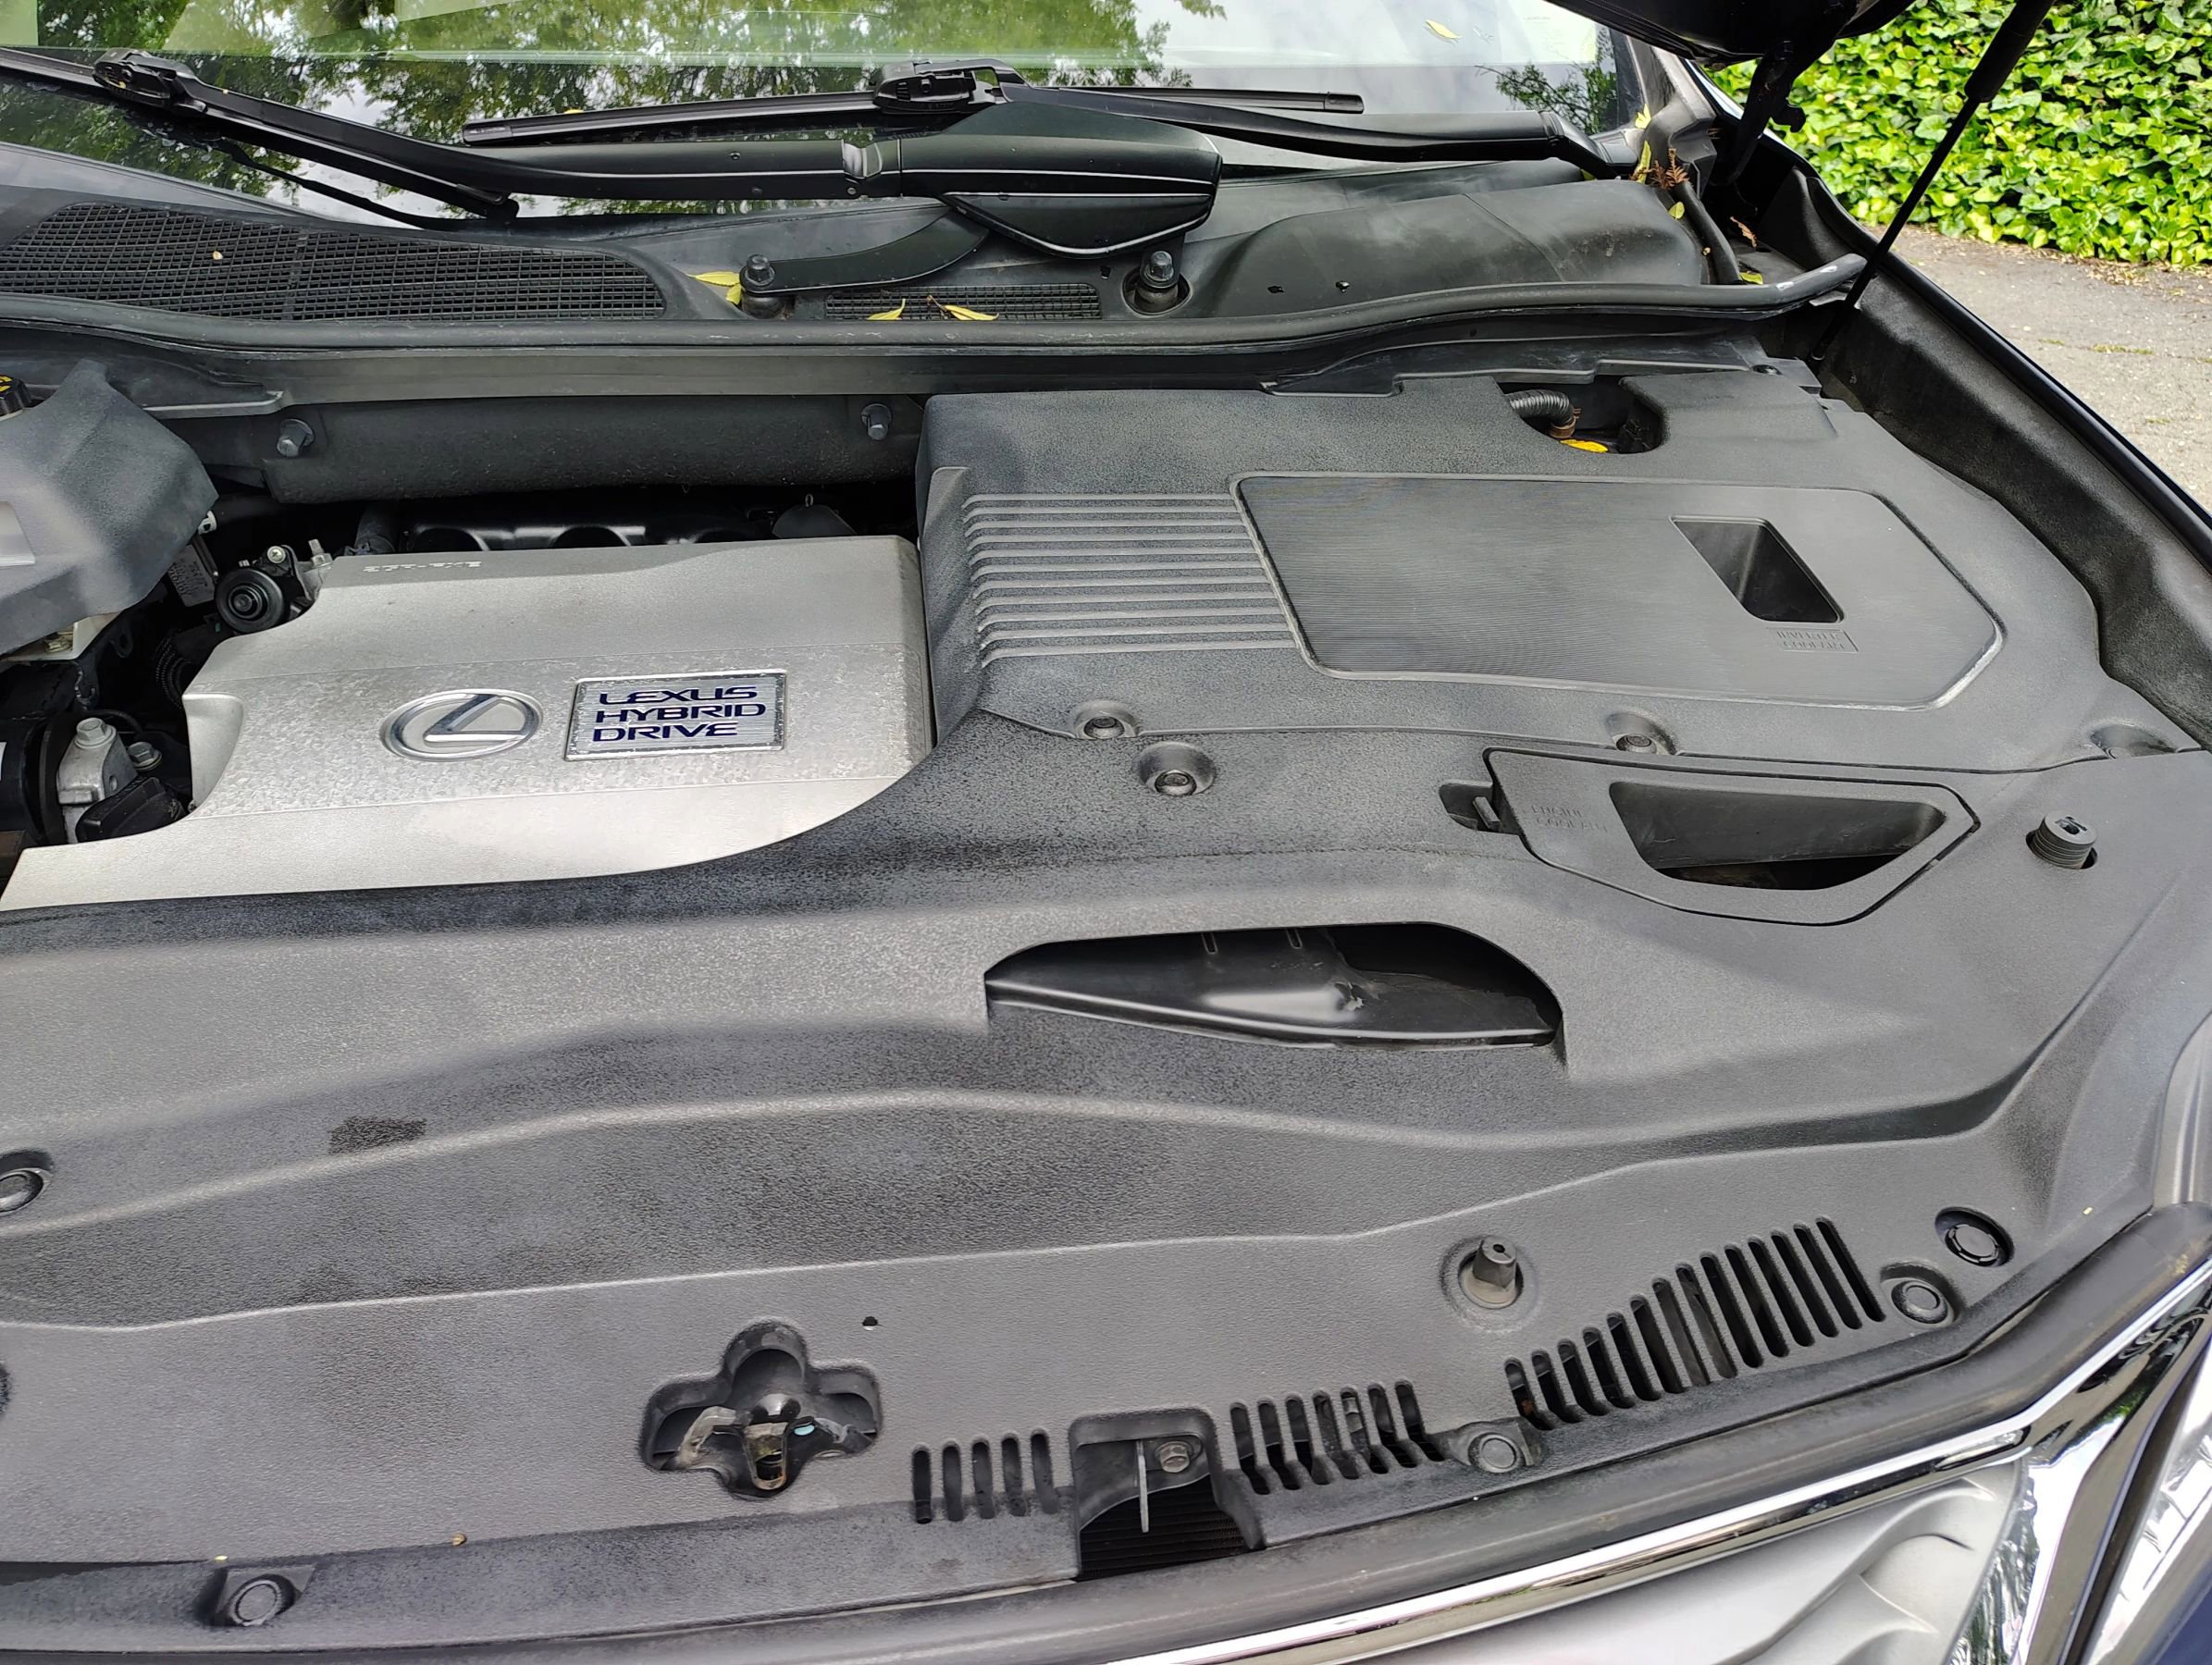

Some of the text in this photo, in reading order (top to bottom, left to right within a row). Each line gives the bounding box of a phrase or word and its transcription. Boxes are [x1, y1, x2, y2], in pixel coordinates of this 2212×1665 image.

[599, 686, 758, 705] LEXUS
[595, 703, 766, 723] HYBRID
[592, 722, 739, 742] DRIVE
